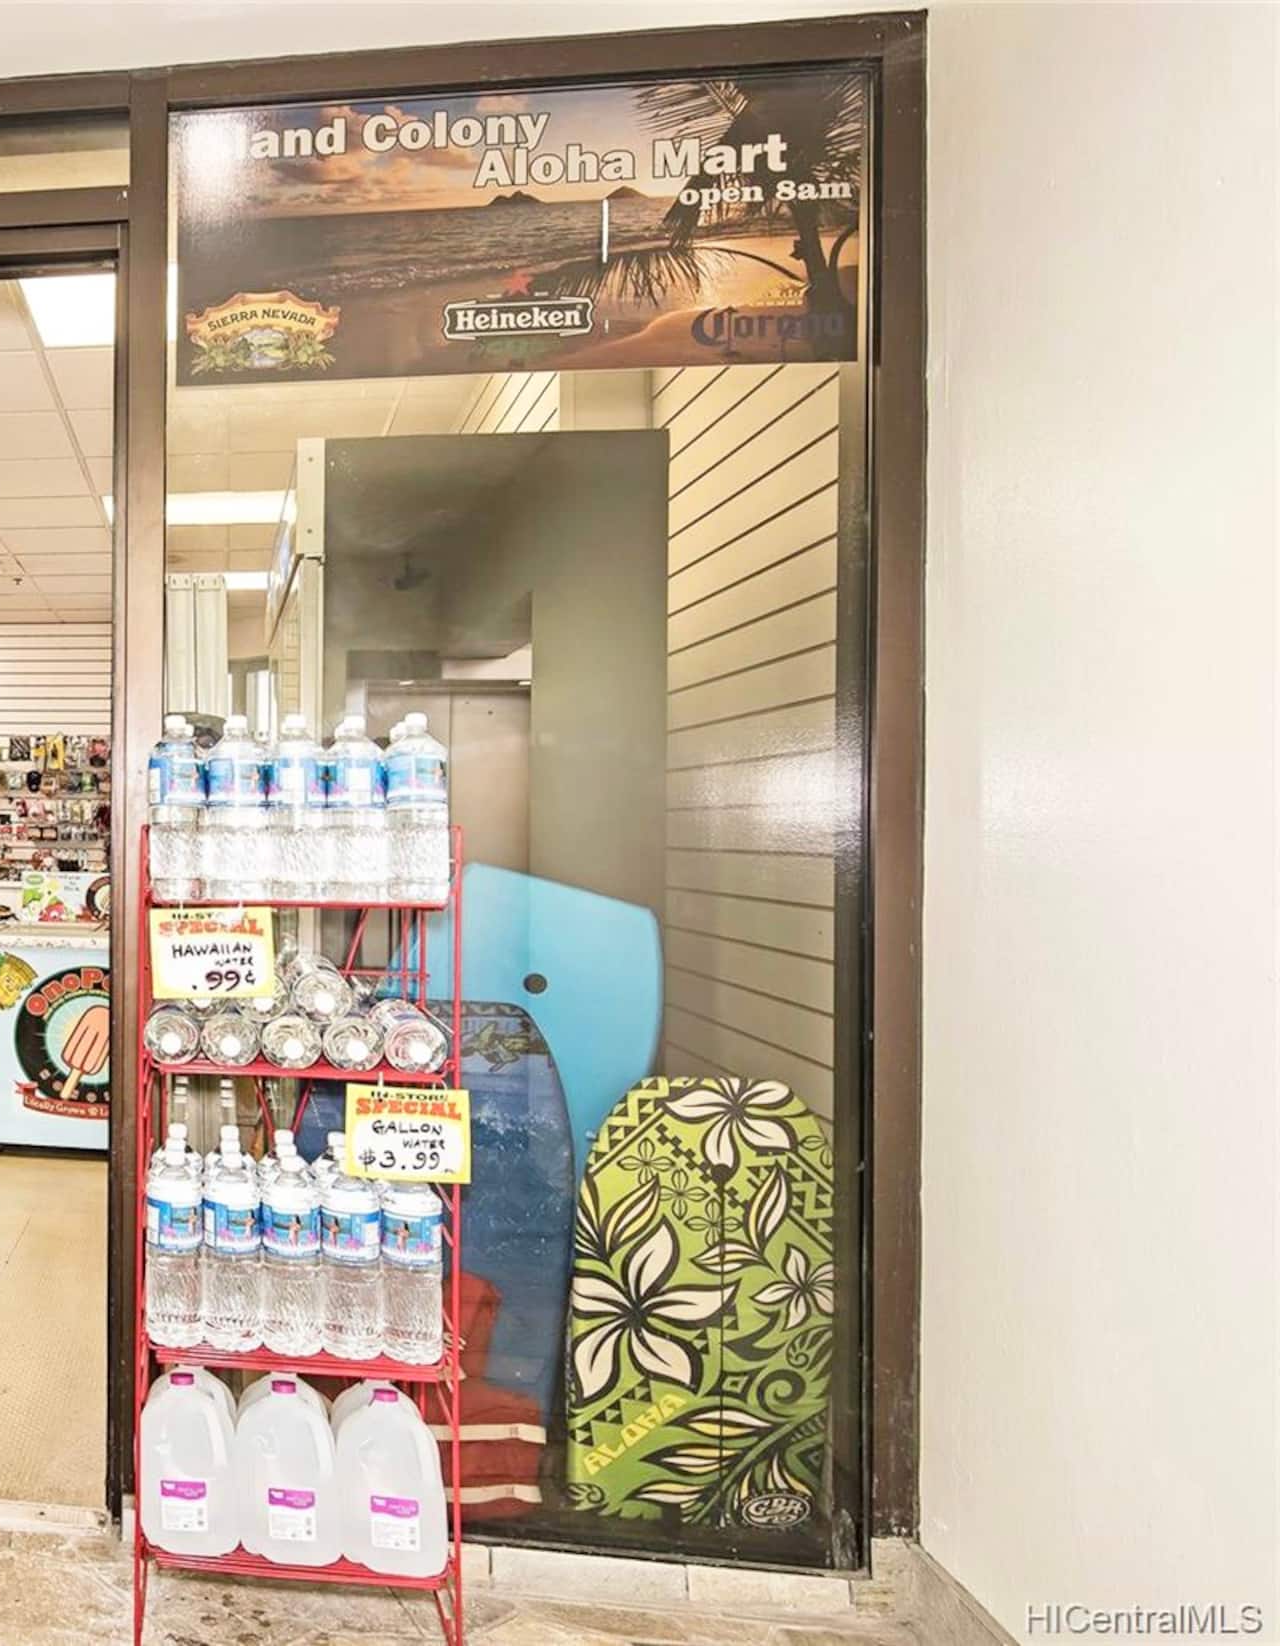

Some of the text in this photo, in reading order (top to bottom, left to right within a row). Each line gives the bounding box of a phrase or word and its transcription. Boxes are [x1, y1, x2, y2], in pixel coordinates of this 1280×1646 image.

[361, 110, 551, 152] Colony
[472, 132, 789, 189] Aloha Mart
[678, 179, 854, 211] open 8am
[207, 308, 316, 330] SIERRA NEVADA
[454, 306, 584, 333] Heineken
[171, 942, 253, 958] HAWAIIAN
[356, 1097, 462, 1121] SPECIAL
[371, 1119, 443, 1136] GALLON
[402, 1138, 446, 1150] WATER
[358, 1148, 440, 1172] $3.99
[583, 1393, 688, 1476] ALOHA
